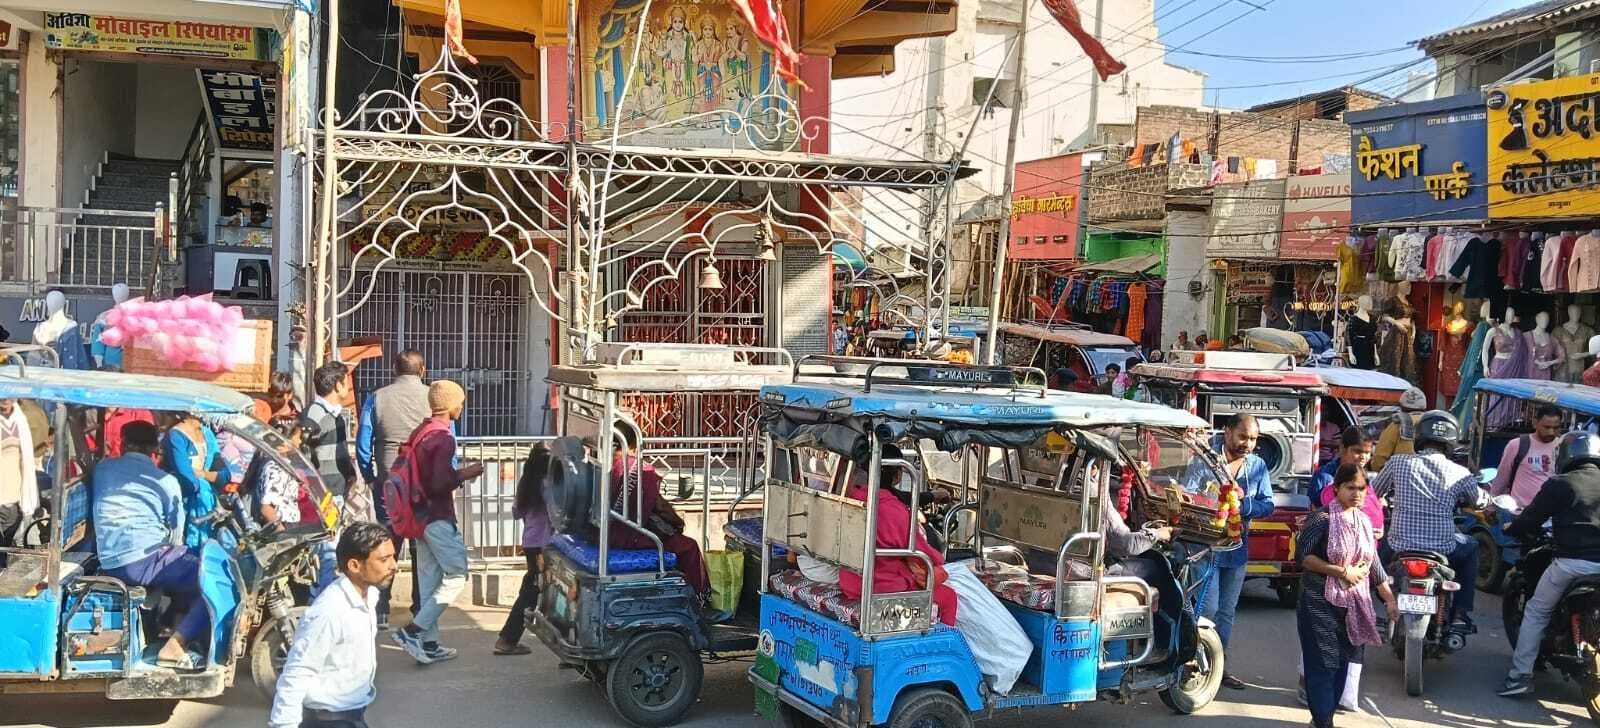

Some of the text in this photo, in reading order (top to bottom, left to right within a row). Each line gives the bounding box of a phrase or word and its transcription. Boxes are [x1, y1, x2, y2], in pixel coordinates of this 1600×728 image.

[93, 16, 170, 38] मोबाइल
[1356, 134, 1426, 182] फैशन
[1424, 160, 1473, 201] पार्क
[1303, 184, 1350, 198] HAVELLS
[949, 369, 985, 382] MAYURI
[880, 607, 921, 621] MAYURI
[1110, 617, 1145, 630] MAYURI
